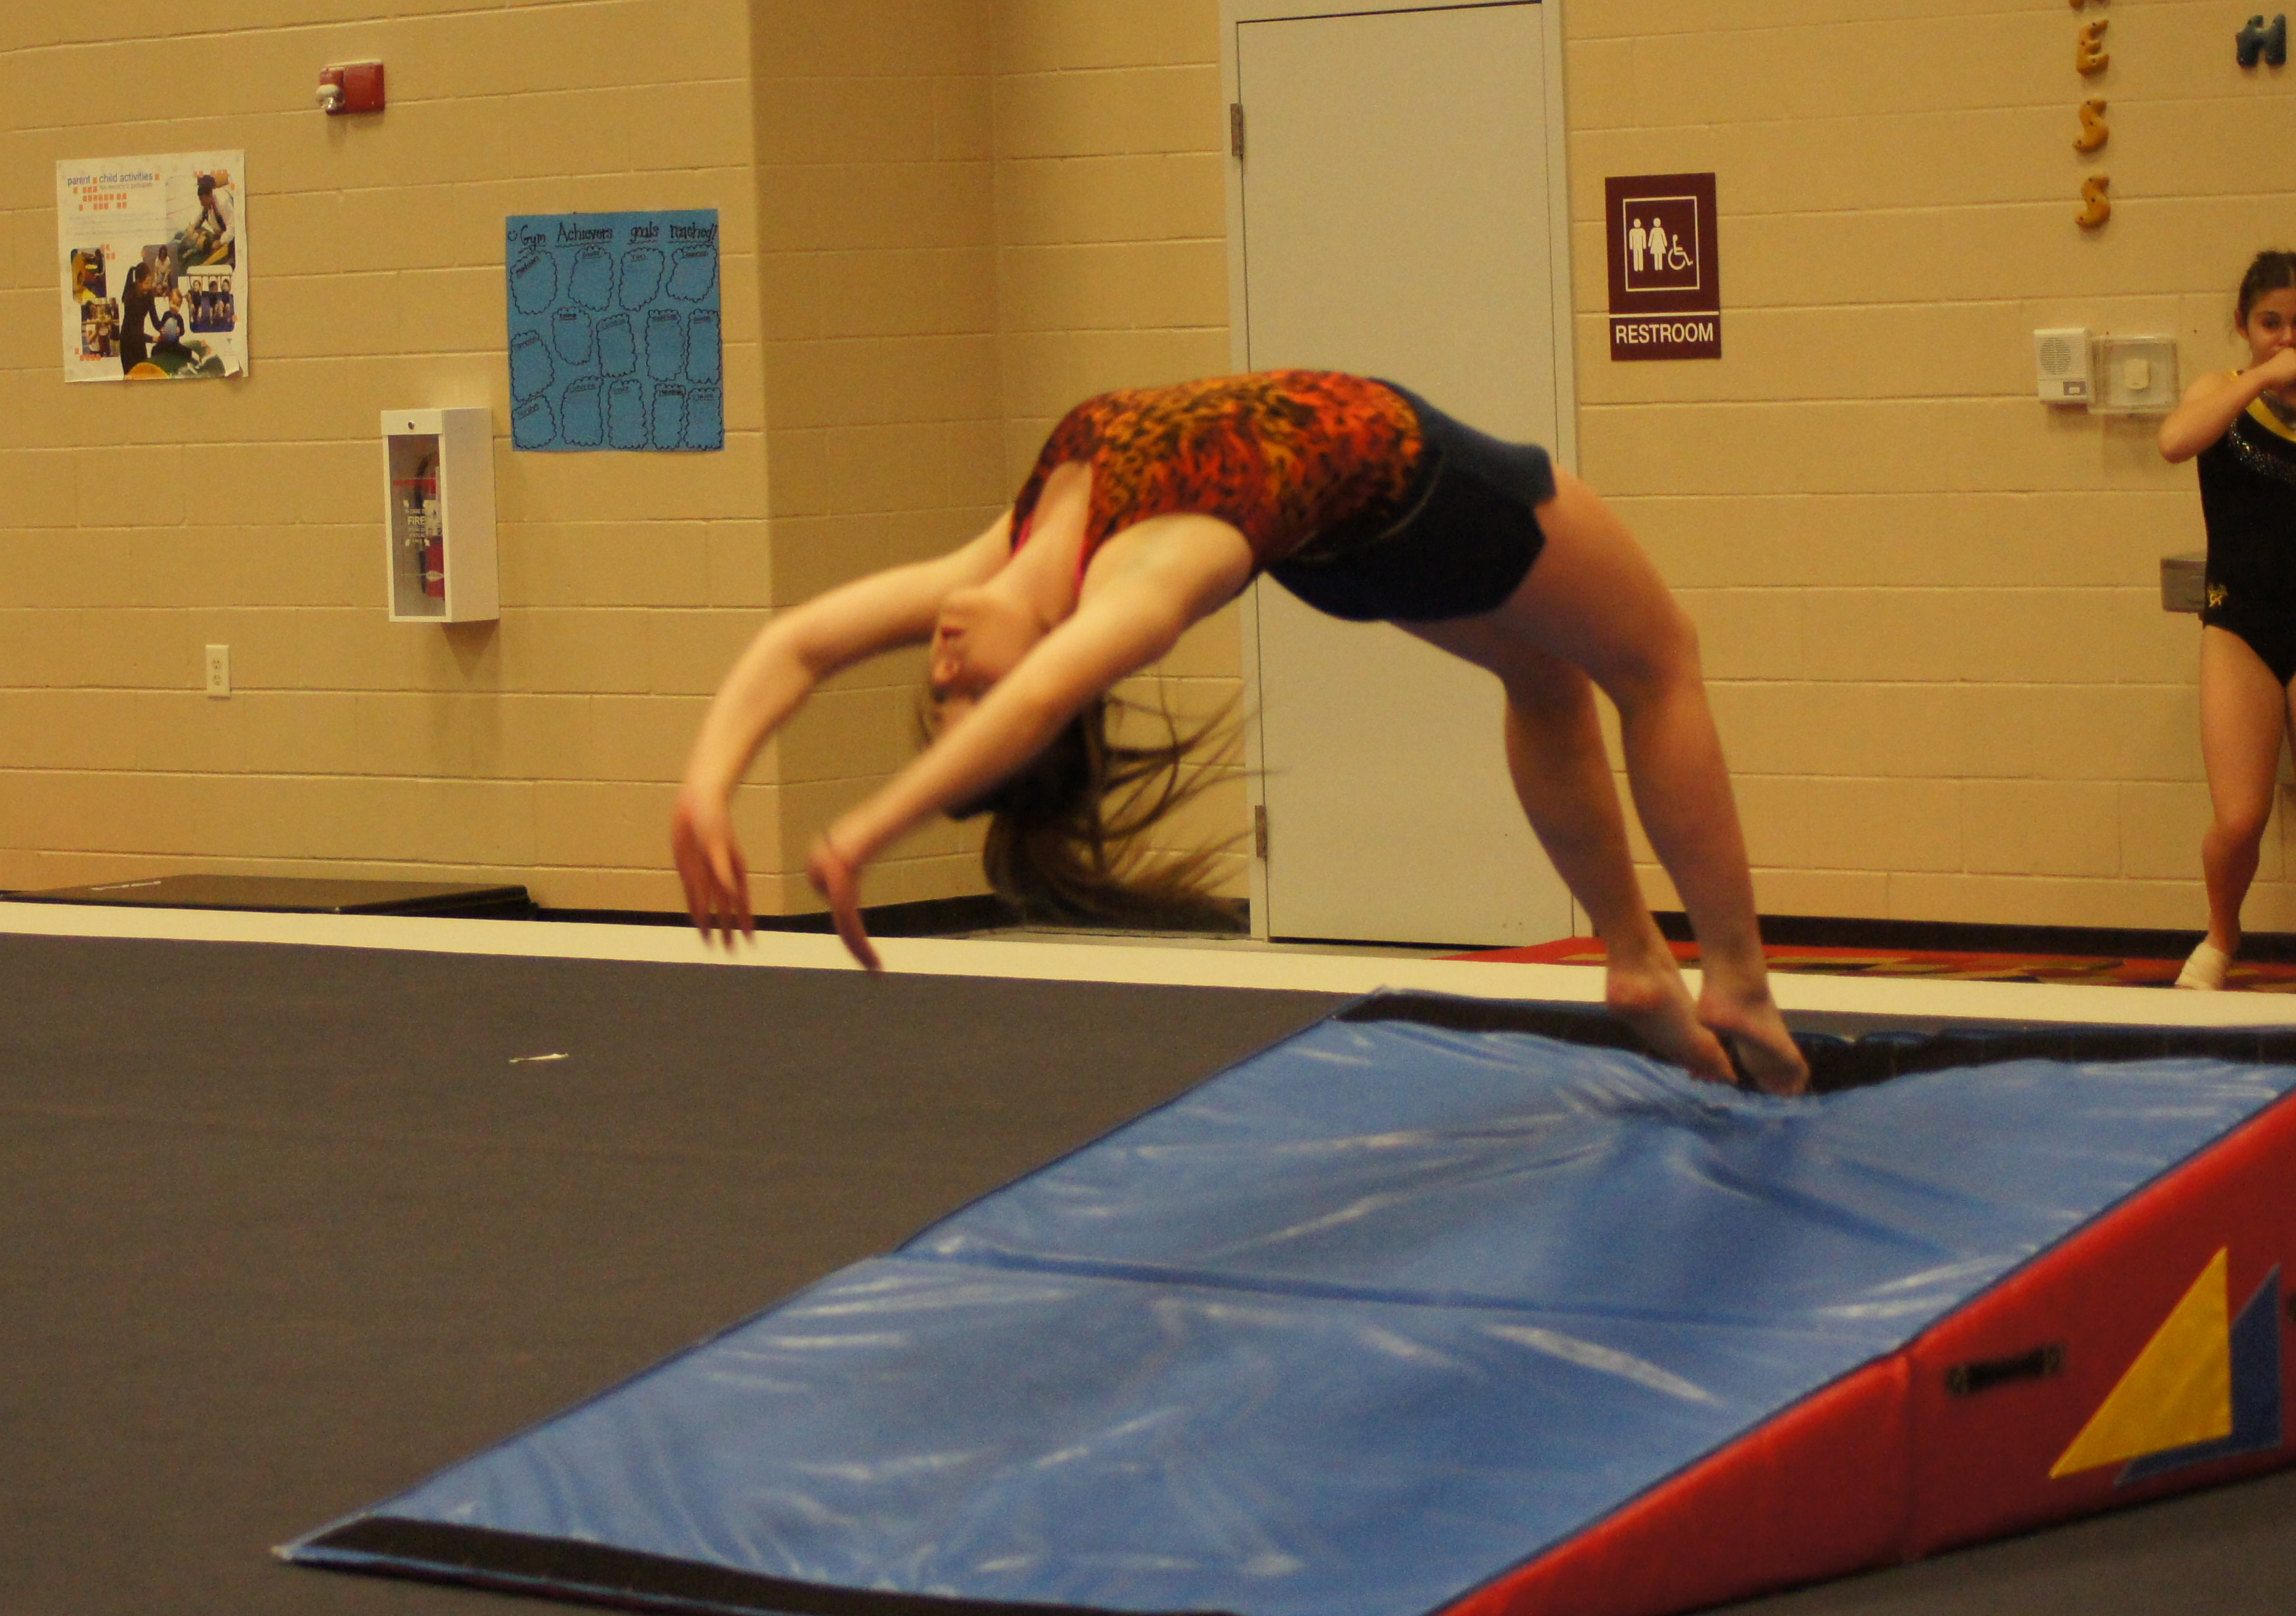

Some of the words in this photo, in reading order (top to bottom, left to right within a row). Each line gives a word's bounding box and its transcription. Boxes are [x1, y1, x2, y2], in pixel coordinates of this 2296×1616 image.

[68, 175, 91, 187] parent
[99, 173, 117, 183] child
[120, 172, 153, 183] activities
[520, 224, 546, 252] Gym
[556, 222, 613, 243] Achievers
[630, 221, 659, 243] goals
[1615, 323, 1714, 344] RESTROOM
[408, 516, 426, 525] FIRE
